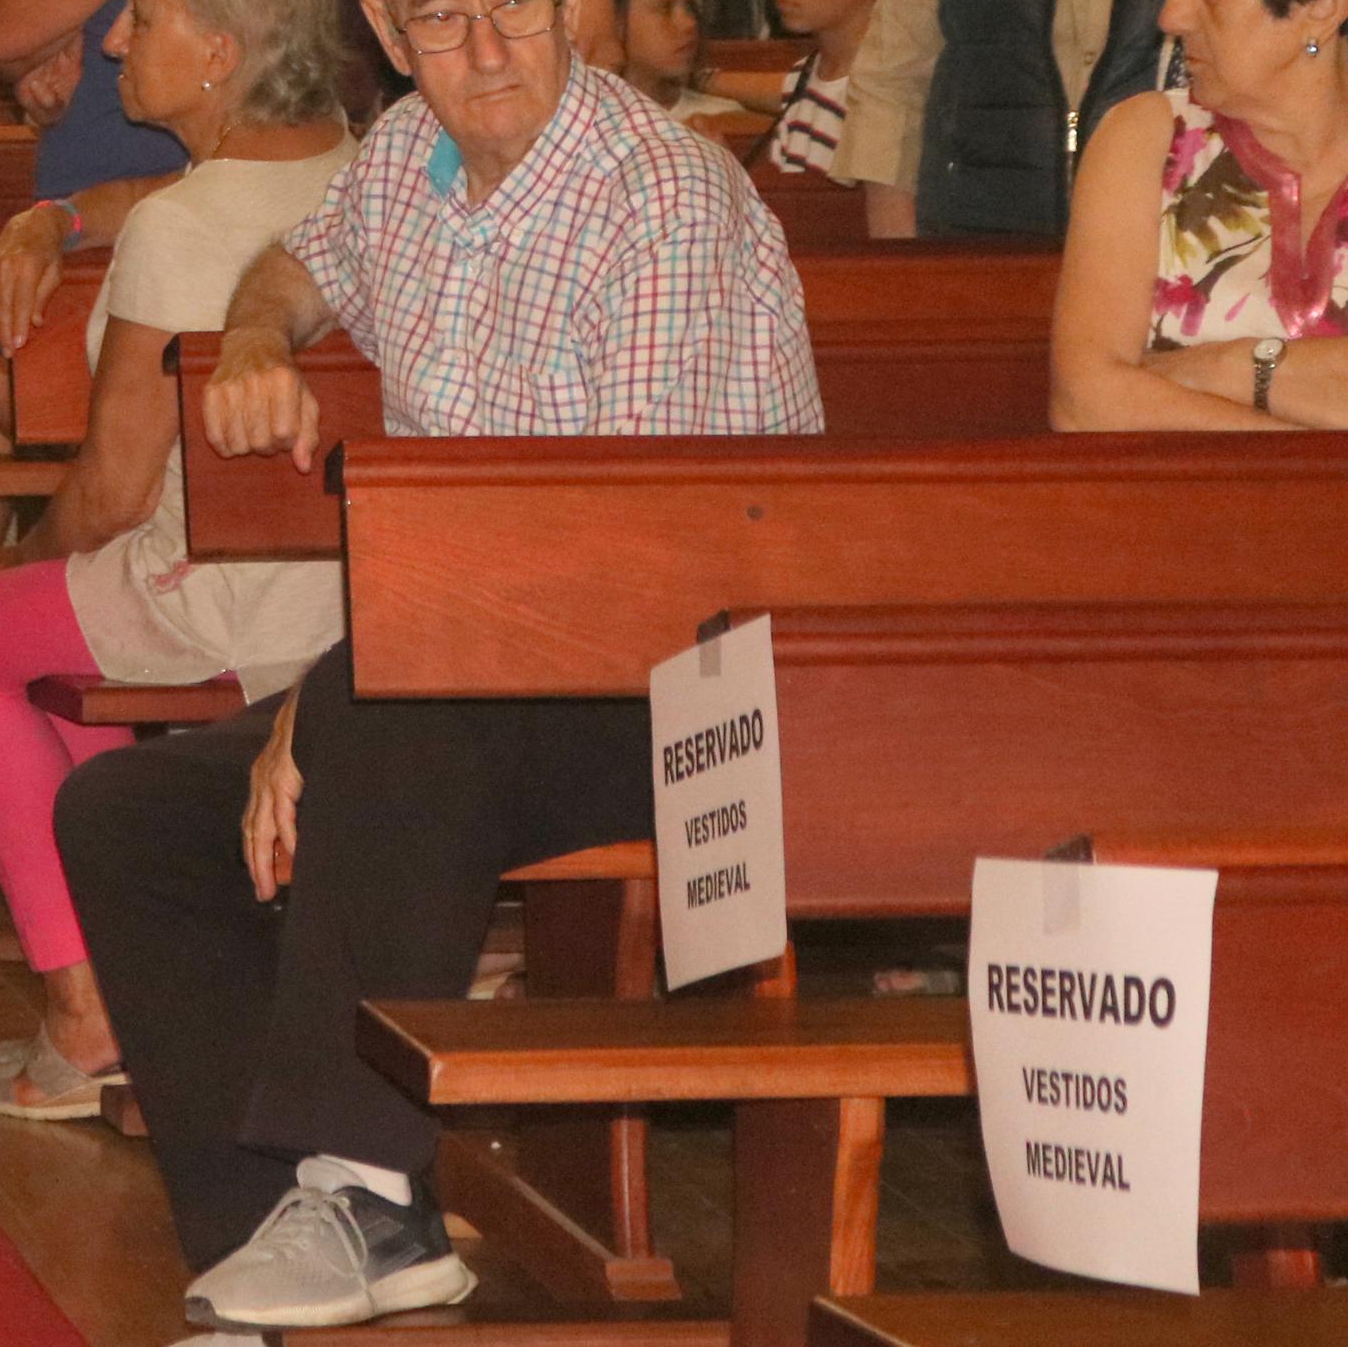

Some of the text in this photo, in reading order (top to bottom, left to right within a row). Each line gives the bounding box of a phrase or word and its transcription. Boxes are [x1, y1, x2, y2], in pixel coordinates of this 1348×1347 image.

[663, 708, 764, 786] RESERVADO
[684, 799, 747, 849] VESTIDOS
[686, 861, 751, 910] MEDIEVAL
[987, 963, 1176, 1027] RESERVADO
[1022, 1067, 1128, 1114] VESTIDOS
[1026, 1141, 1130, 1191] MEDIEVAL
